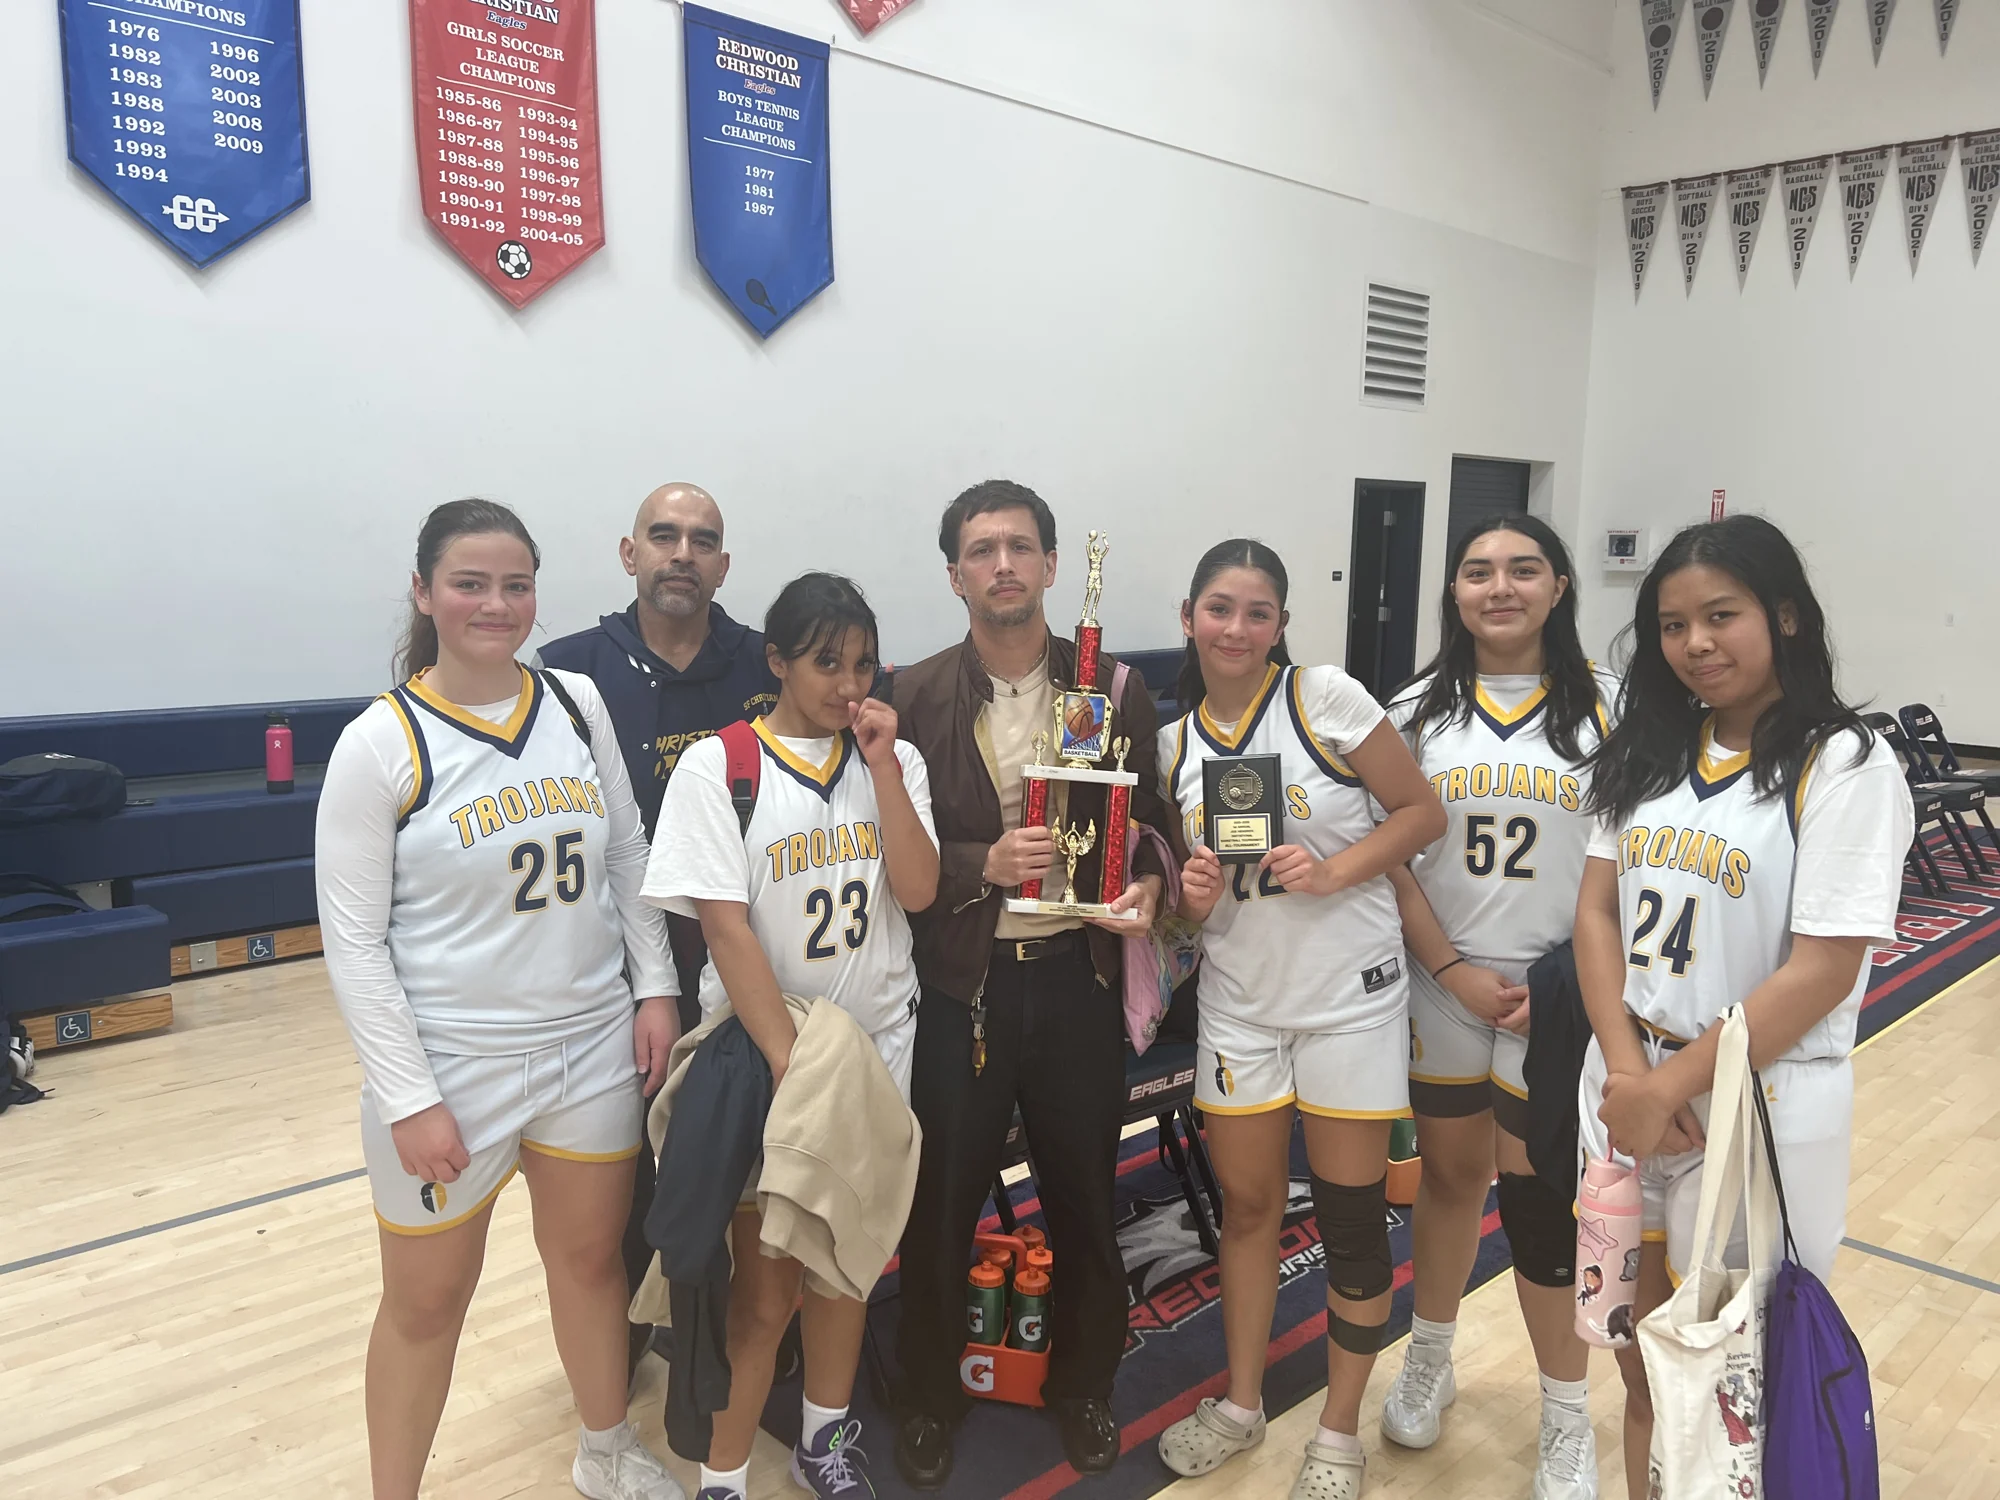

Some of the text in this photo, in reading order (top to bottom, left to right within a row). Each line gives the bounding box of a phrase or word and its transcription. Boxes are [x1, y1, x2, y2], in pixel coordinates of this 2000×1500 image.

[127, 0, 247, 26] AMPIONS
[471, 0, 559, 24] RISTIAN
[486, 10, 528, 30] Eagles
[1875, 1, 1888, 45] 2010
[107, 19, 160, 41] 1976
[446, 21, 565, 61] GIRLS SOCCER
[1814, 16, 1827, 58] 2010
[109, 43, 161, 65] 1982
[210, 41, 260, 63] 1996
[717, 36, 799, 71] REDWOOD
[1760, 27, 1771, 69] 2010
[475, 47, 540, 74] LEAGUE
[715, 53, 801, 89] CHRISTIAN
[110, 67, 163, 89] 1983
[210, 64, 261, 86] 2002
[459, 62, 556, 95] CHAMPIONS
[211, 87, 262, 109] 2003
[436, 86, 502, 112] 1985-86
[743, 79, 776, 96] Eagles
[111, 91, 164, 112] 1988
[717, 90, 800, 121] BOYS TENNIS
[112, 115, 166, 136] 1992
[212, 110, 263, 132] 2008
[437, 107, 502, 132] 1986-87
[517, 106, 578, 131] 1993-94
[735, 111, 784, 133] LEAGUE
[113, 139, 167, 159] 1993
[213, 133, 264, 154] 2009
[438, 128, 504, 153] 1987-88
[518, 126, 579, 150] 1994-95
[721, 124, 796, 151] CHAMPIONS
[1975, 144, 2000, 154] GIRLS
[438, 150, 504, 173] 1988-89
[519, 147, 580, 170] 1995-96
[1787, 160, 1828, 173] CHOLASTC
[1899, 162, 1946, 174] VOLLEYBALL
[1911, 154, 1935, 164] GIRLS
[115, 162, 168, 183] 1994
[439, 170, 505, 194] 1989-90
[520, 167, 580, 189] 1996-97
[745, 164, 775, 181] 1977
[1732, 170, 1771, 182] CHOLASTC
[1785, 173, 1823, 184] BASEBALL
[1839, 170, 1884, 183] VOLLEYBALL
[1968, 164, 2000, 192] NCS
[520, 187, 582, 208] 1997-98
[744, 183, 774, 199] 1981
[1678, 191, 1712, 201] SOFTBALL
[1730, 188, 1766, 199] SWIMMING
[1738, 181, 1760, 190] GIRLS
[1846, 182, 1875, 209] NCS
[1905, 174, 1936, 202] NCS
[439, 191, 504, 214] 1990-91
[744, 201, 775, 216] 1987
[1631, 206, 1656, 214] SOCCER
[1789, 186, 1817, 212] NCS
[1971, 195, 1984, 203] DIV
[441, 212, 505, 234] 1991-92
[520, 207, 582, 228] 1998-99
[1681, 203, 1707, 228] NCS
[1733, 201, 1760, 226] NCS
[520, 226, 583, 246] 2004-05
[1630, 216, 1655, 240] NCS
[1911, 214, 1925, 258] 2021
[1973, 204, 1988, 249] 2022
[1738, 231, 1751, 272] 2019
[1793, 228, 1807, 270] 2019
[1850, 221, 1864, 264] 2019
[1634, 251, 1645, 290] 2019
[1686, 243, 1697, 283] 2019
[1430, 763, 1580, 811] TROJANS
[450, 777, 605, 849] TROJANS
[766, 821, 884, 883] TROJAN
[1464, 812, 1539, 881] 52
[507, 828, 587, 915] 25
[1618, 825, 1751, 899] TROJANS
[804, 877, 871, 962] 23
[1628, 886, 1699, 978] 24
[1129, 1068, 1195, 1101] EAGLES
[1018, 1315, 1042, 1342] G
[960, 1355, 994, 1392] G
